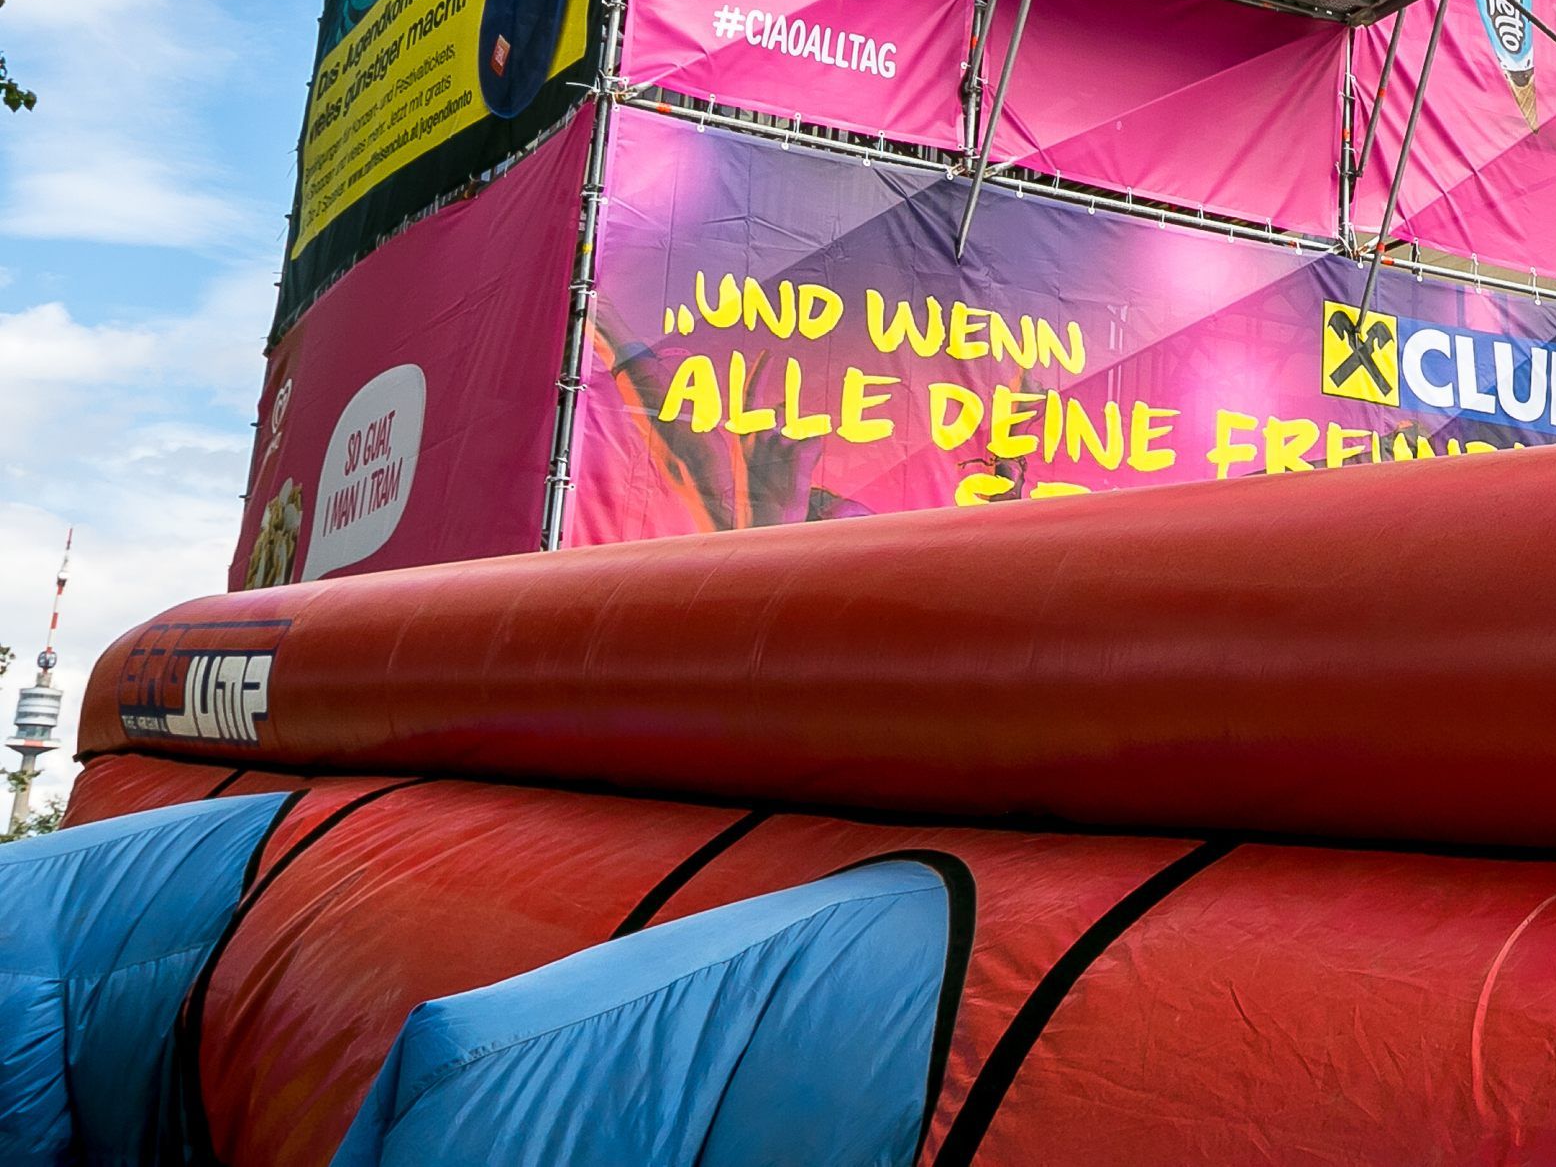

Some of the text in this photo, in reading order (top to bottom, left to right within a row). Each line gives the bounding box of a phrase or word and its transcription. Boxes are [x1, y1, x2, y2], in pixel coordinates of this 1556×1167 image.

[343, 33, 405, 118] günstiger
[713, 4, 898, 79] #CIAOALLTAG
[867, 289, 1086, 374] WENN
[344, 430, 362, 476] SO
[363, 410, 396, 465] GUAT,
[658, 350, 901, 443] ALLE
[928, 383, 1181, 473] DEINE
[330, 480, 360, 533] MAN
[368, 456, 403, 515] TRAM
[166, 655, 273, 741] JUMP
